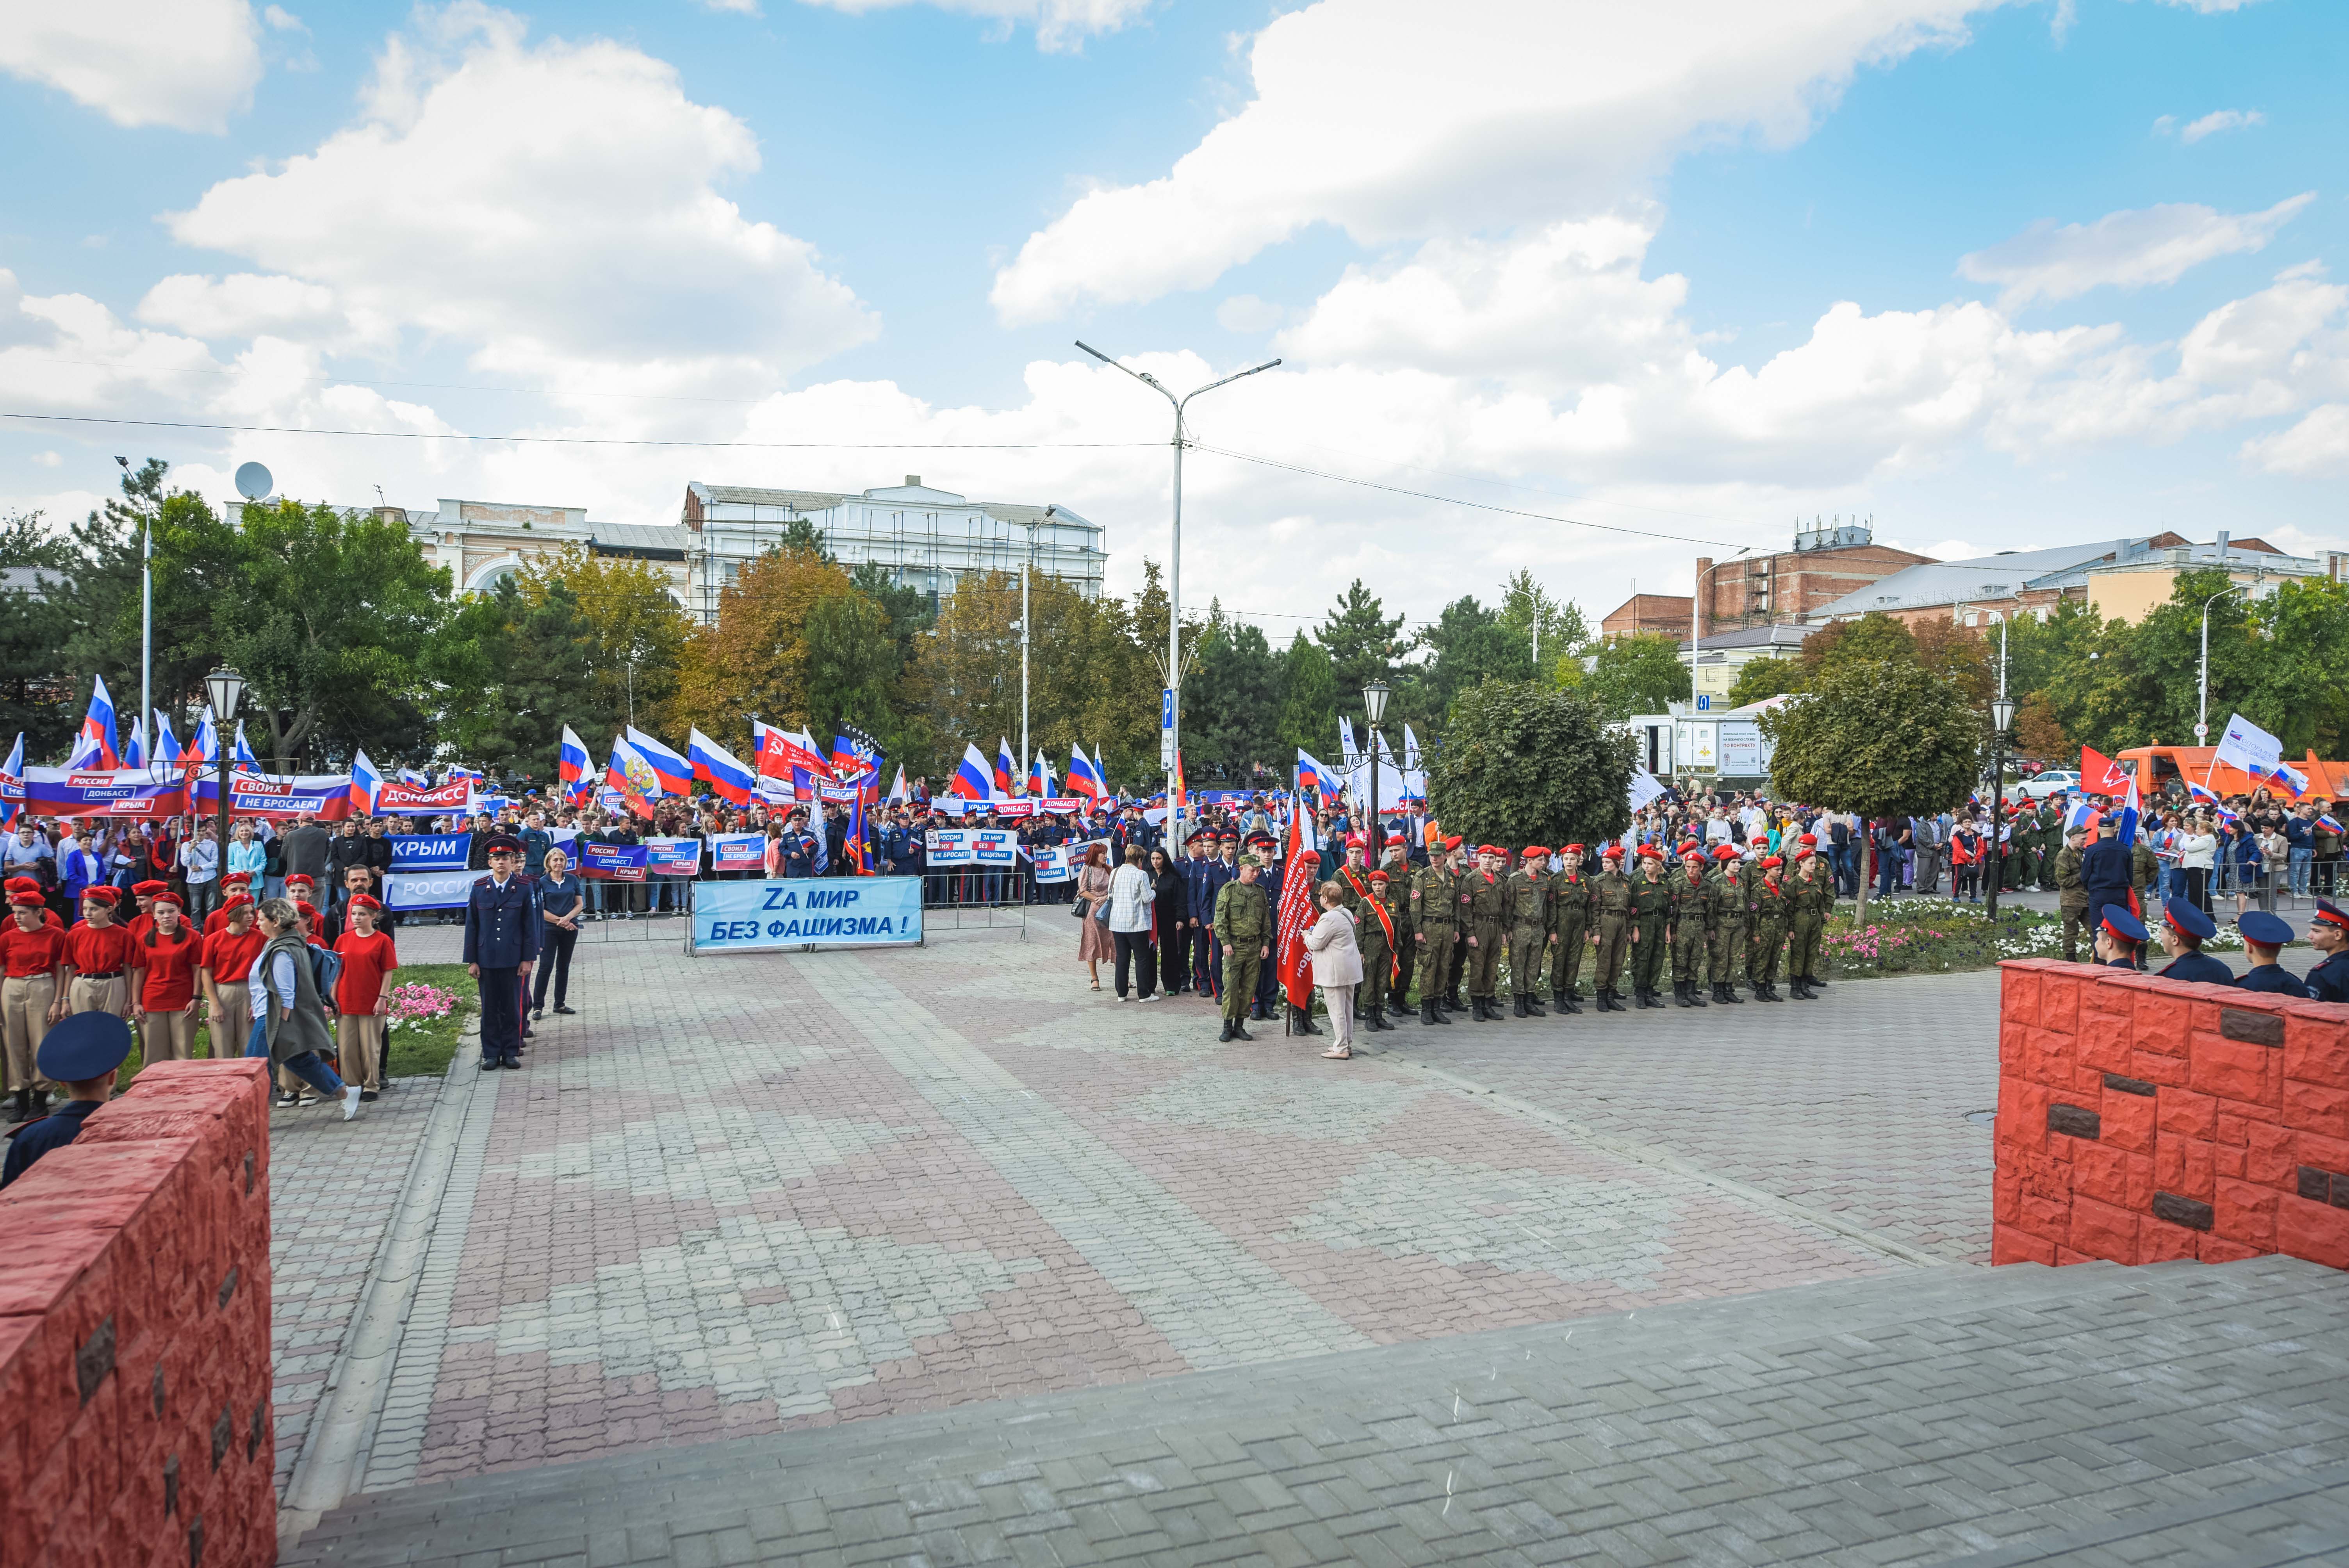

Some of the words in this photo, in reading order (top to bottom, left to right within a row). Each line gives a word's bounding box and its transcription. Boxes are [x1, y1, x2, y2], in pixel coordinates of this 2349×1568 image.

[1165, 693, 1171, 725] P
[845, 725, 882, 749] ДОНЕЦК
[2242, 738, 2262, 754] ОПОРА
[8, 787, 23, 795] НЕ
[239, 782, 282, 793] СВОИХ
[820, 780, 840, 788] ВОИХ
[384, 787, 465, 803] ДОНБАСС
[245, 798, 260, 807] НЕ
[263, 798, 317, 809] БРОСАЕМ
[999, 805, 1030, 813] ДОНБАСС
[391, 841, 456, 856] КРЫМ
[403, 880, 471, 896] РОССИ
[806, 890, 859, 909] МИР
[1277, 875, 1308, 958] ВОЕННО-ПАТРИОТИЧЕ
[710, 920, 759, 940] БЕЗ
[767, 917, 893, 938] ФАШИЗМА
[1282, 902, 1306, 965] ОБЩЕСТВЕННОГО
